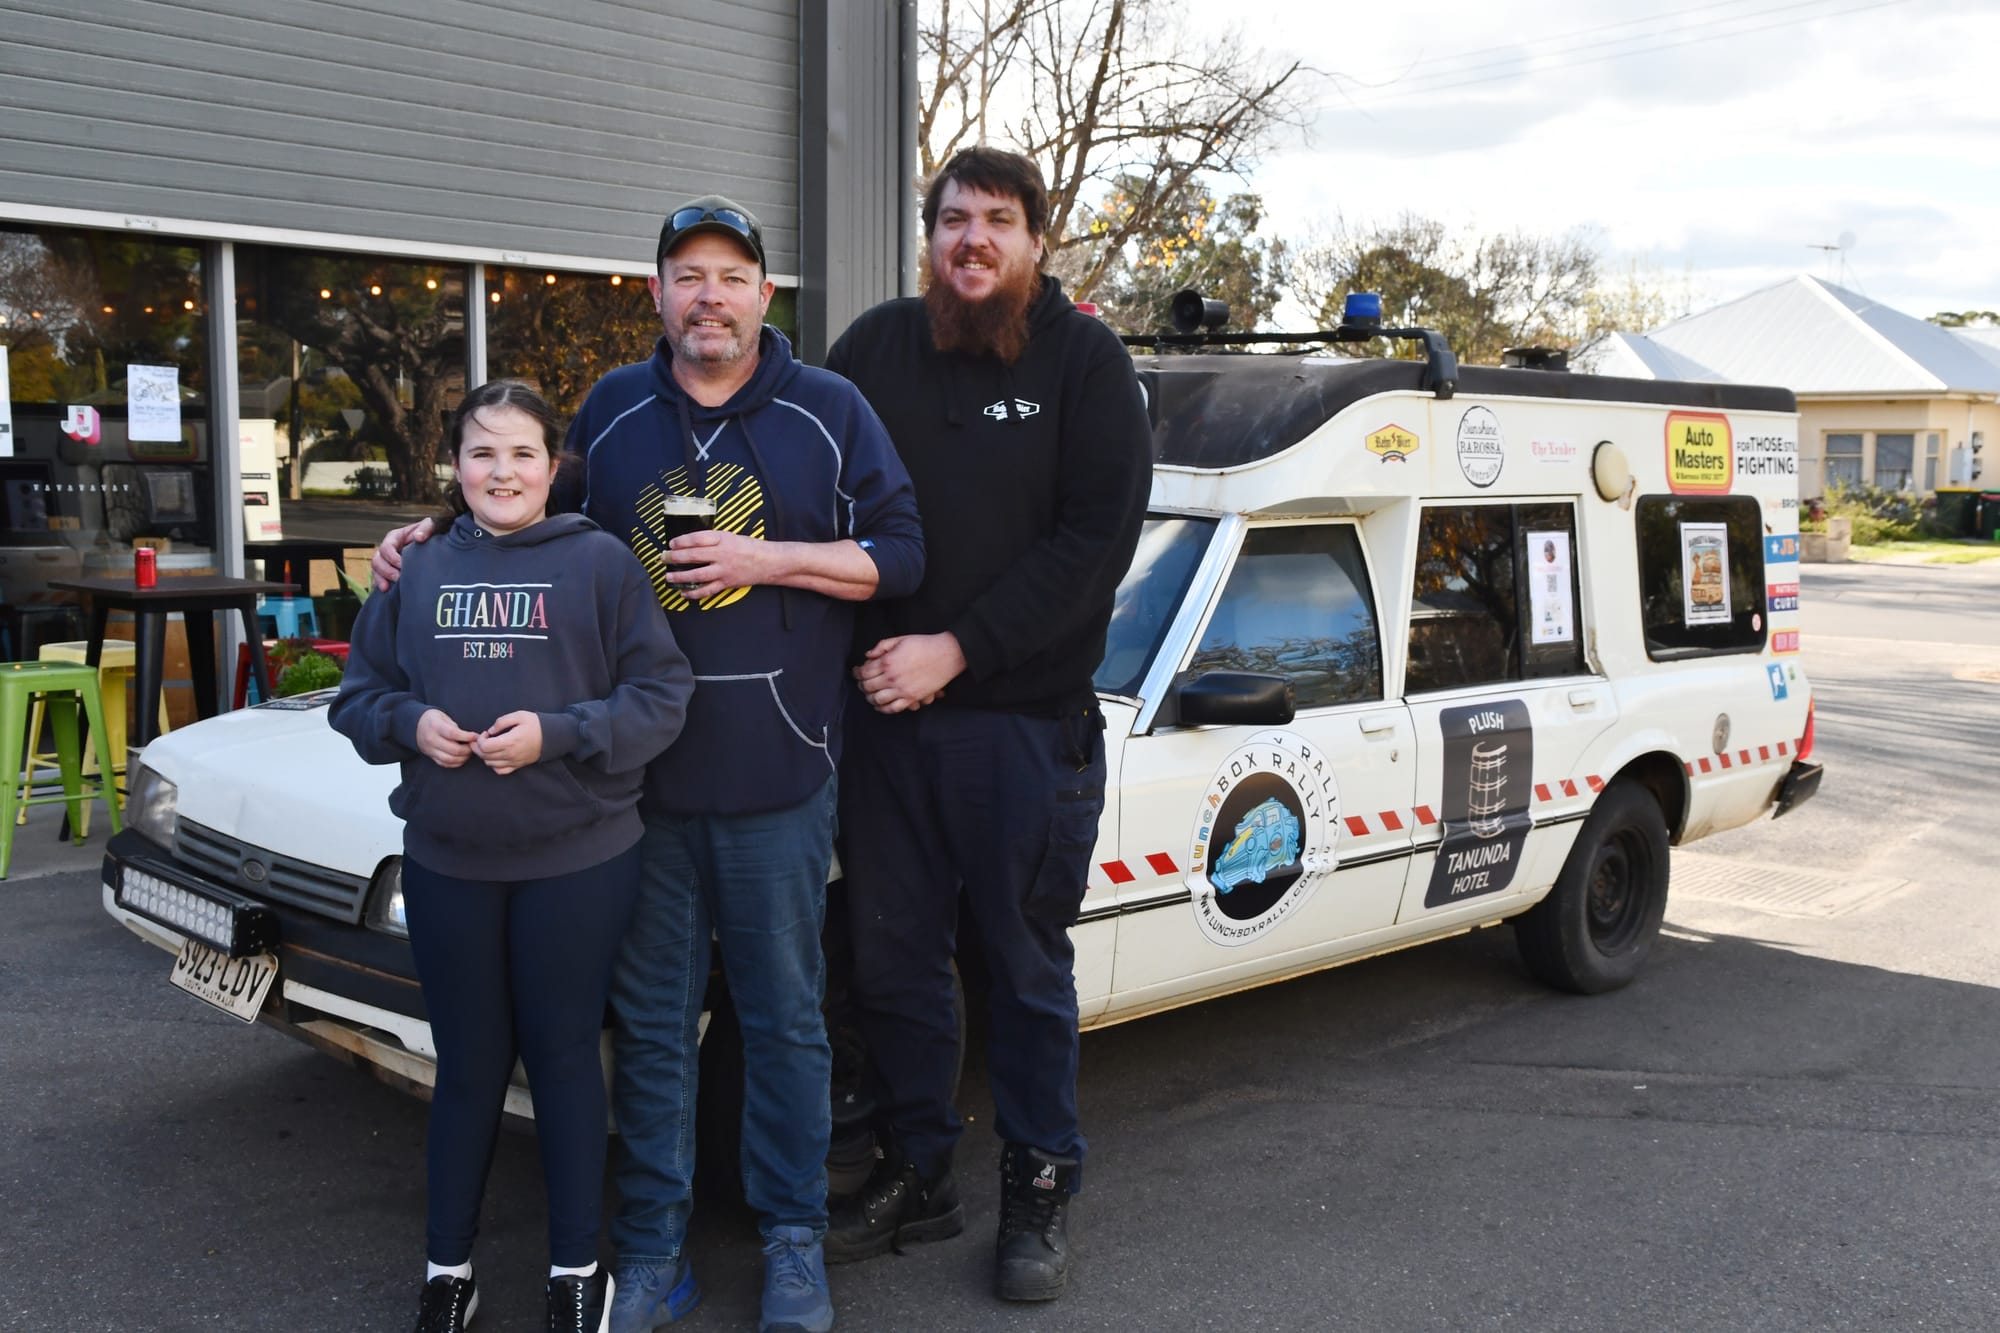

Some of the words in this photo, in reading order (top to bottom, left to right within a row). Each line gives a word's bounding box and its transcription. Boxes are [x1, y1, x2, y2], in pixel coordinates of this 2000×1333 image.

[1685, 426, 1714, 446] Auto
[1750, 437, 1783, 452] THOSE
[1460, 440, 1502, 455] BAROSSA
[1675, 449, 1724, 470] Masters
[436, 591, 548, 629] GHANDA
[463, 641, 487, 659] EST.
[488, 641, 514, 659] 1984
[1468, 711, 1505, 735] PLUSH
[1272, 752, 1320, 819] RALLY
[1300, 745, 1338, 826] RALLY
[1447, 841, 1511, 875] TANUNDA
[1450, 871, 1490, 896] HOTEL
[202, 987, 235, 1008] AUSTRALIA
